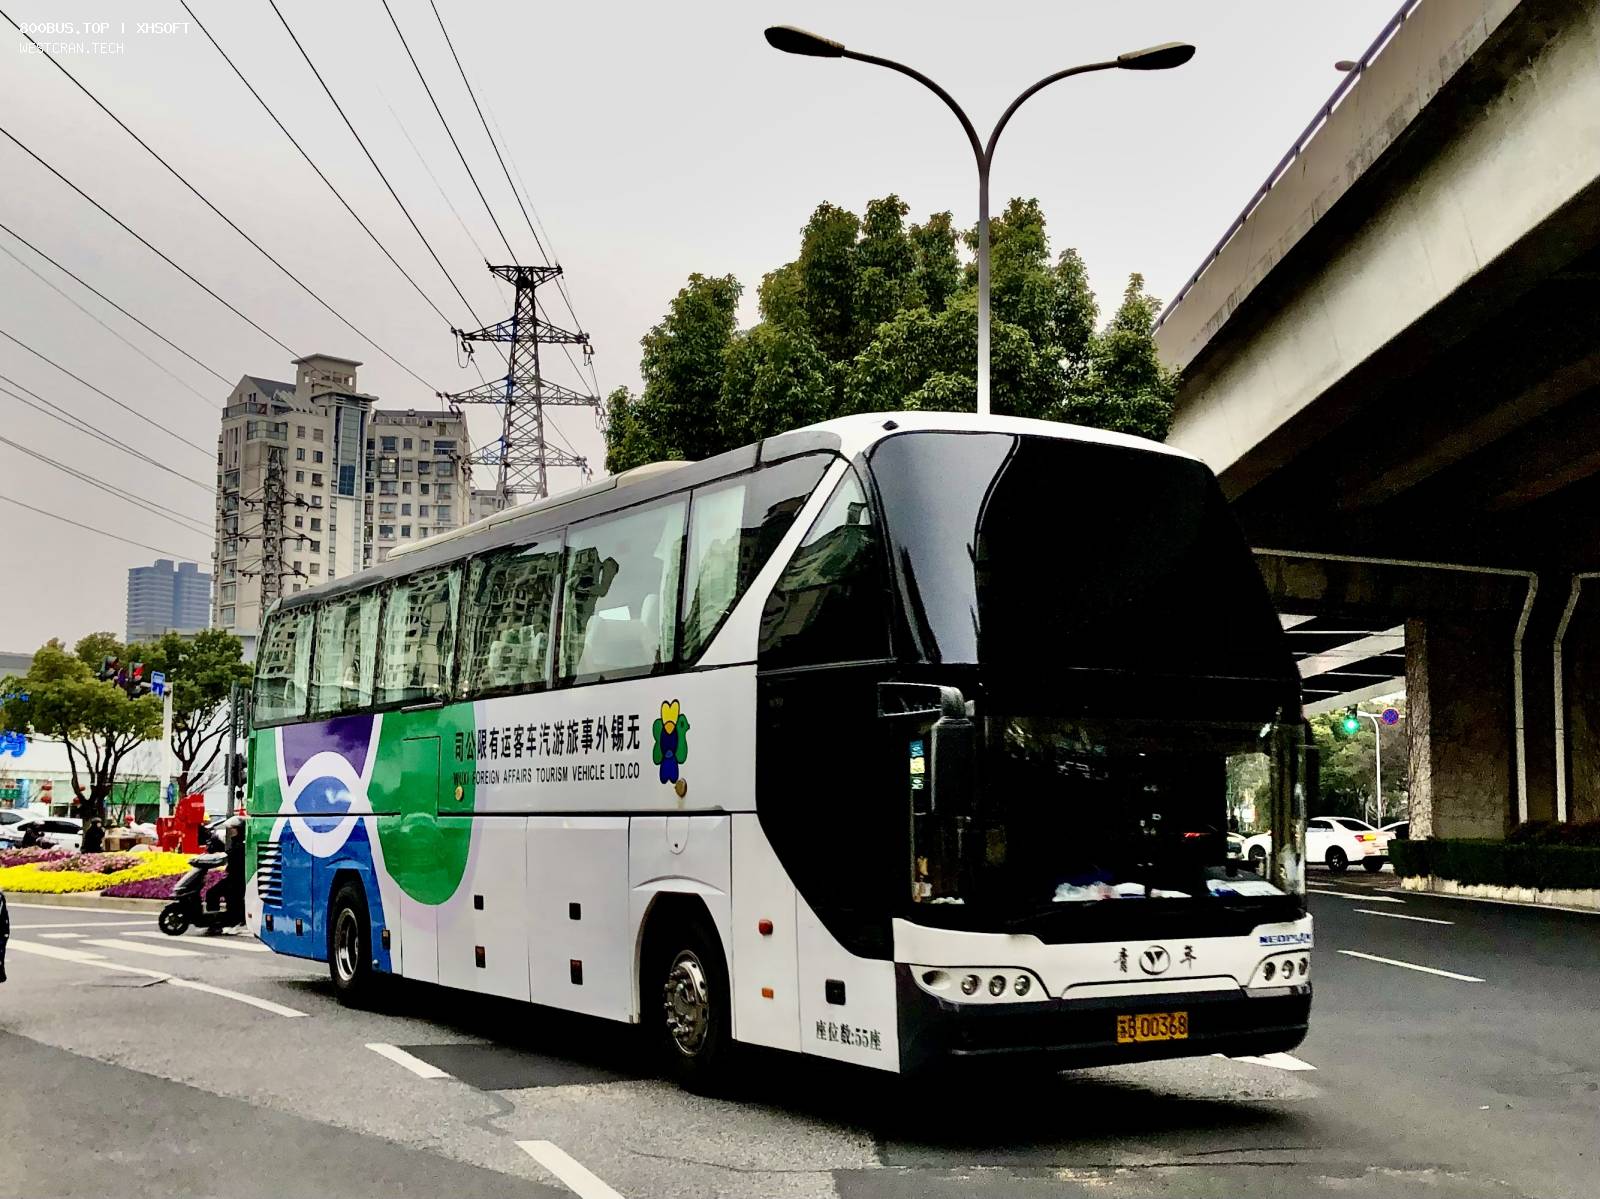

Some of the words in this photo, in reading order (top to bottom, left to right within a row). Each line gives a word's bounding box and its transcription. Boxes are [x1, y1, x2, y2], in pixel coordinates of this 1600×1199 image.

[472, 770, 500, 785] FOREIGN
[503, 768, 532, 784] AFFAIRS
[536, 766, 568, 783] TOURISM
[572, 764, 605, 781] VEHICLE
[610, 762, 640, 780] LTD.CO
